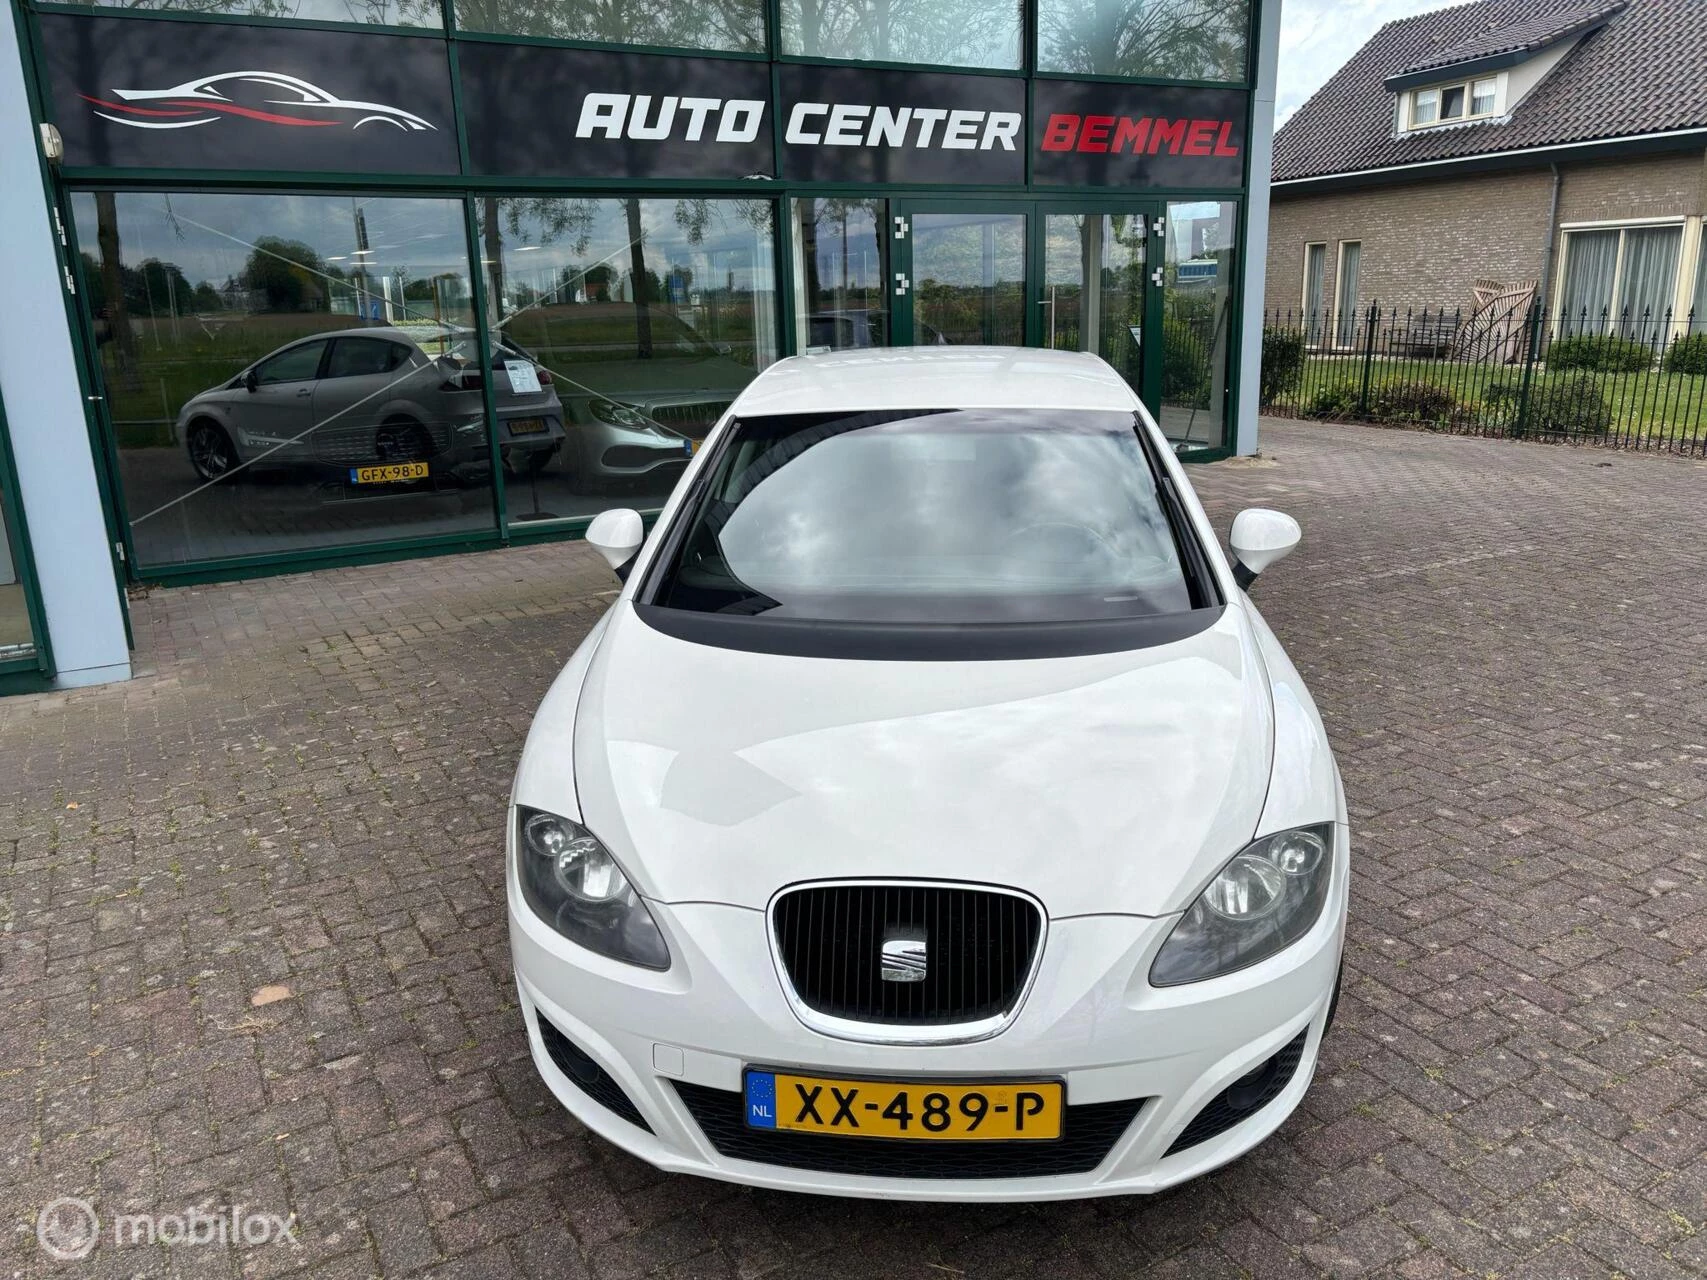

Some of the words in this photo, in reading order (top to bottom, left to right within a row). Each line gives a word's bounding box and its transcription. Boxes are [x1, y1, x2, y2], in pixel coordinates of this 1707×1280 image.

[575, 92, 766, 143] AUTO
[785, 102, 1022, 151] CENTER
[1041, 114, 1238, 157] BEMMEL
[361, 464, 424, 482] GFX-98-D
[752, 1104, 773, 1118] NL
[794, 1083, 1045, 1133] XX-489-P
